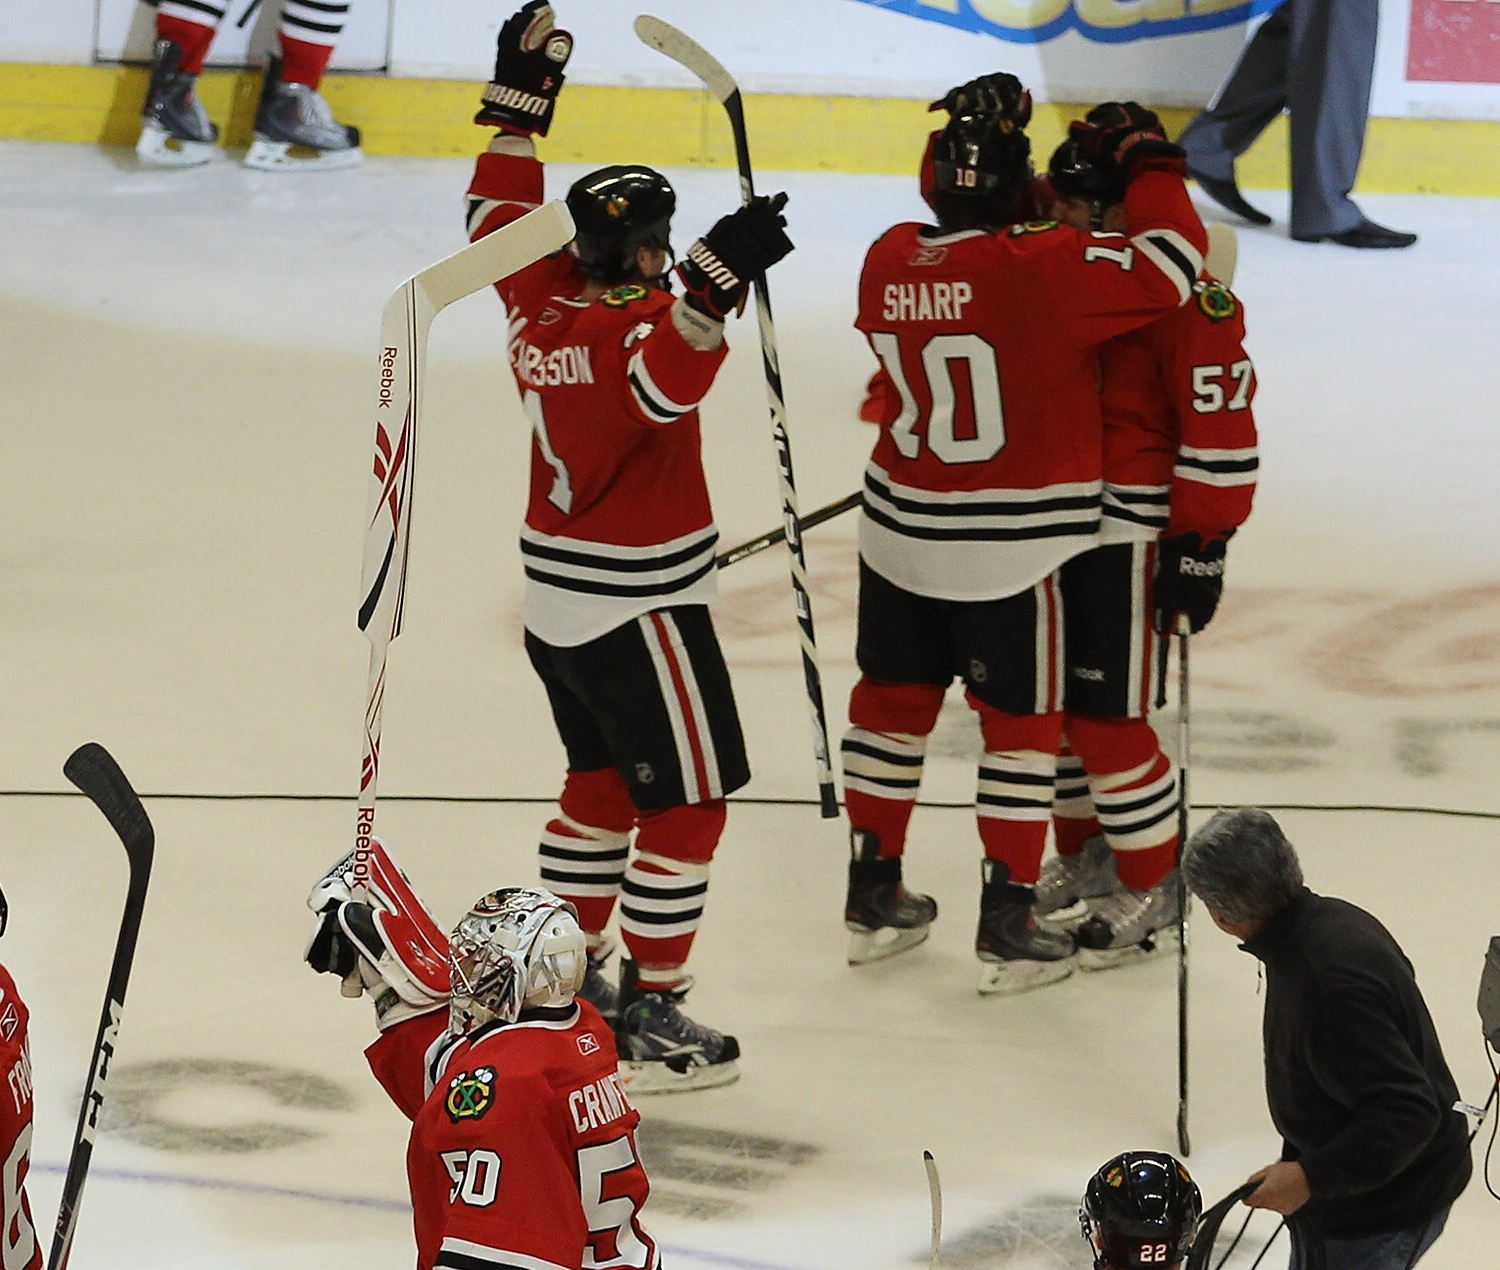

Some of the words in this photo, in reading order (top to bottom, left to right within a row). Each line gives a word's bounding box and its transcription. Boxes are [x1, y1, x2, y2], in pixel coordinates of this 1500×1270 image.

[955, 167, 977, 188] 10
[882, 281, 973, 322] SHARP
[378, 346, 398, 409] Reebok
[870, 332, 1006, 464] 10
[1192, 359, 1252, 413] 57
[352, 806, 375, 890] Reebok
[78, 997, 125, 1144] CCM
[440, 1149, 502, 1207] 50
[1140, 1243, 1168, 1263] 22
